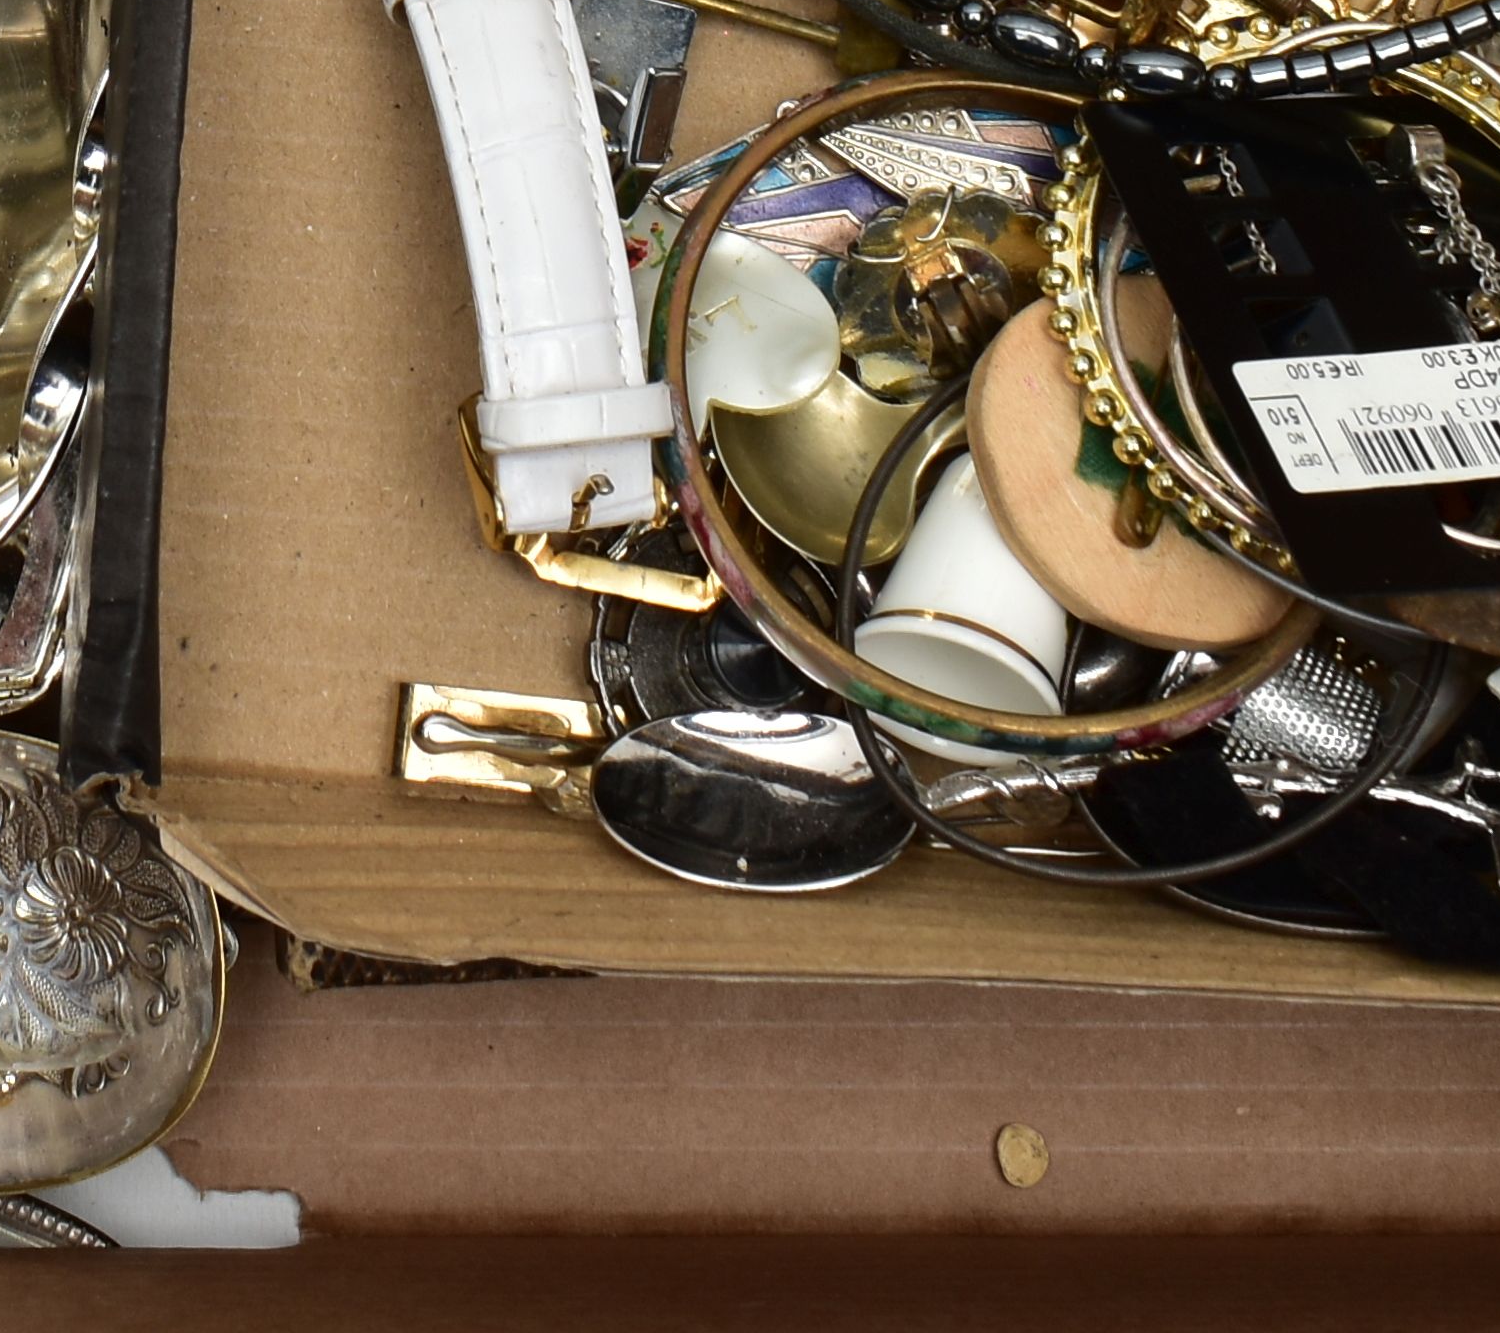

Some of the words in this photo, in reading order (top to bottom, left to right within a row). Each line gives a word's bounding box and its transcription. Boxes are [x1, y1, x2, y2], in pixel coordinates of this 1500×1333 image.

[1267, 407, 1301, 426] 510
[1353, 402, 1433, 425] 060921
[1289, 432, 1308, 444] NO
[1293, 453, 1323, 467] DEPT
